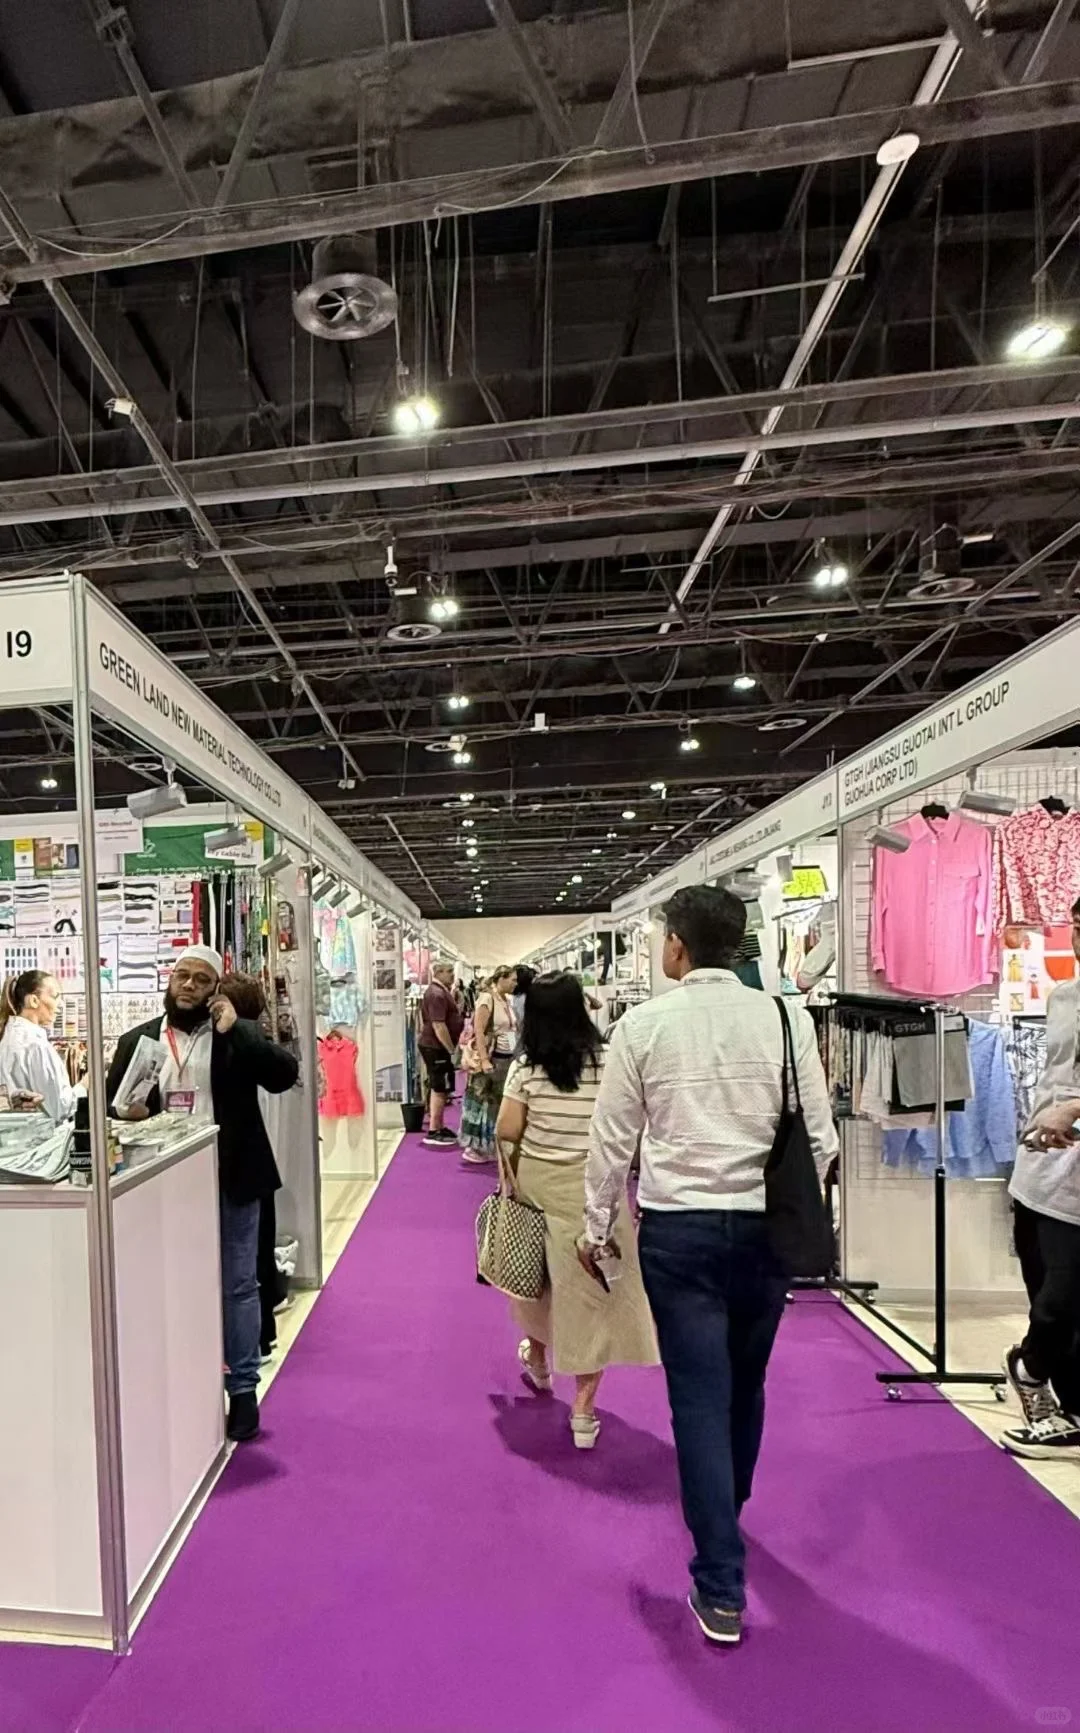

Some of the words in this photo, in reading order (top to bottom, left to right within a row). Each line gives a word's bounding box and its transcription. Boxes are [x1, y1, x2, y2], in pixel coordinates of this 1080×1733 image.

[100, 642, 140, 696] GREEN
[143, 677, 170, 717] LAND
[171, 700, 191, 735] NEW
[193, 720, 227, 766] MATERIAL
[844, 765, 864, 787] GTGH
[865, 742, 901, 778] (JIANGSU
[902, 722, 936, 756] GUOTAI
[966, 681, 1010, 721] GROUP
[844, 782, 874, 807] GUOHUA
[875, 768, 897, 792] CORP
[899, 757, 918, 781] LTD)
